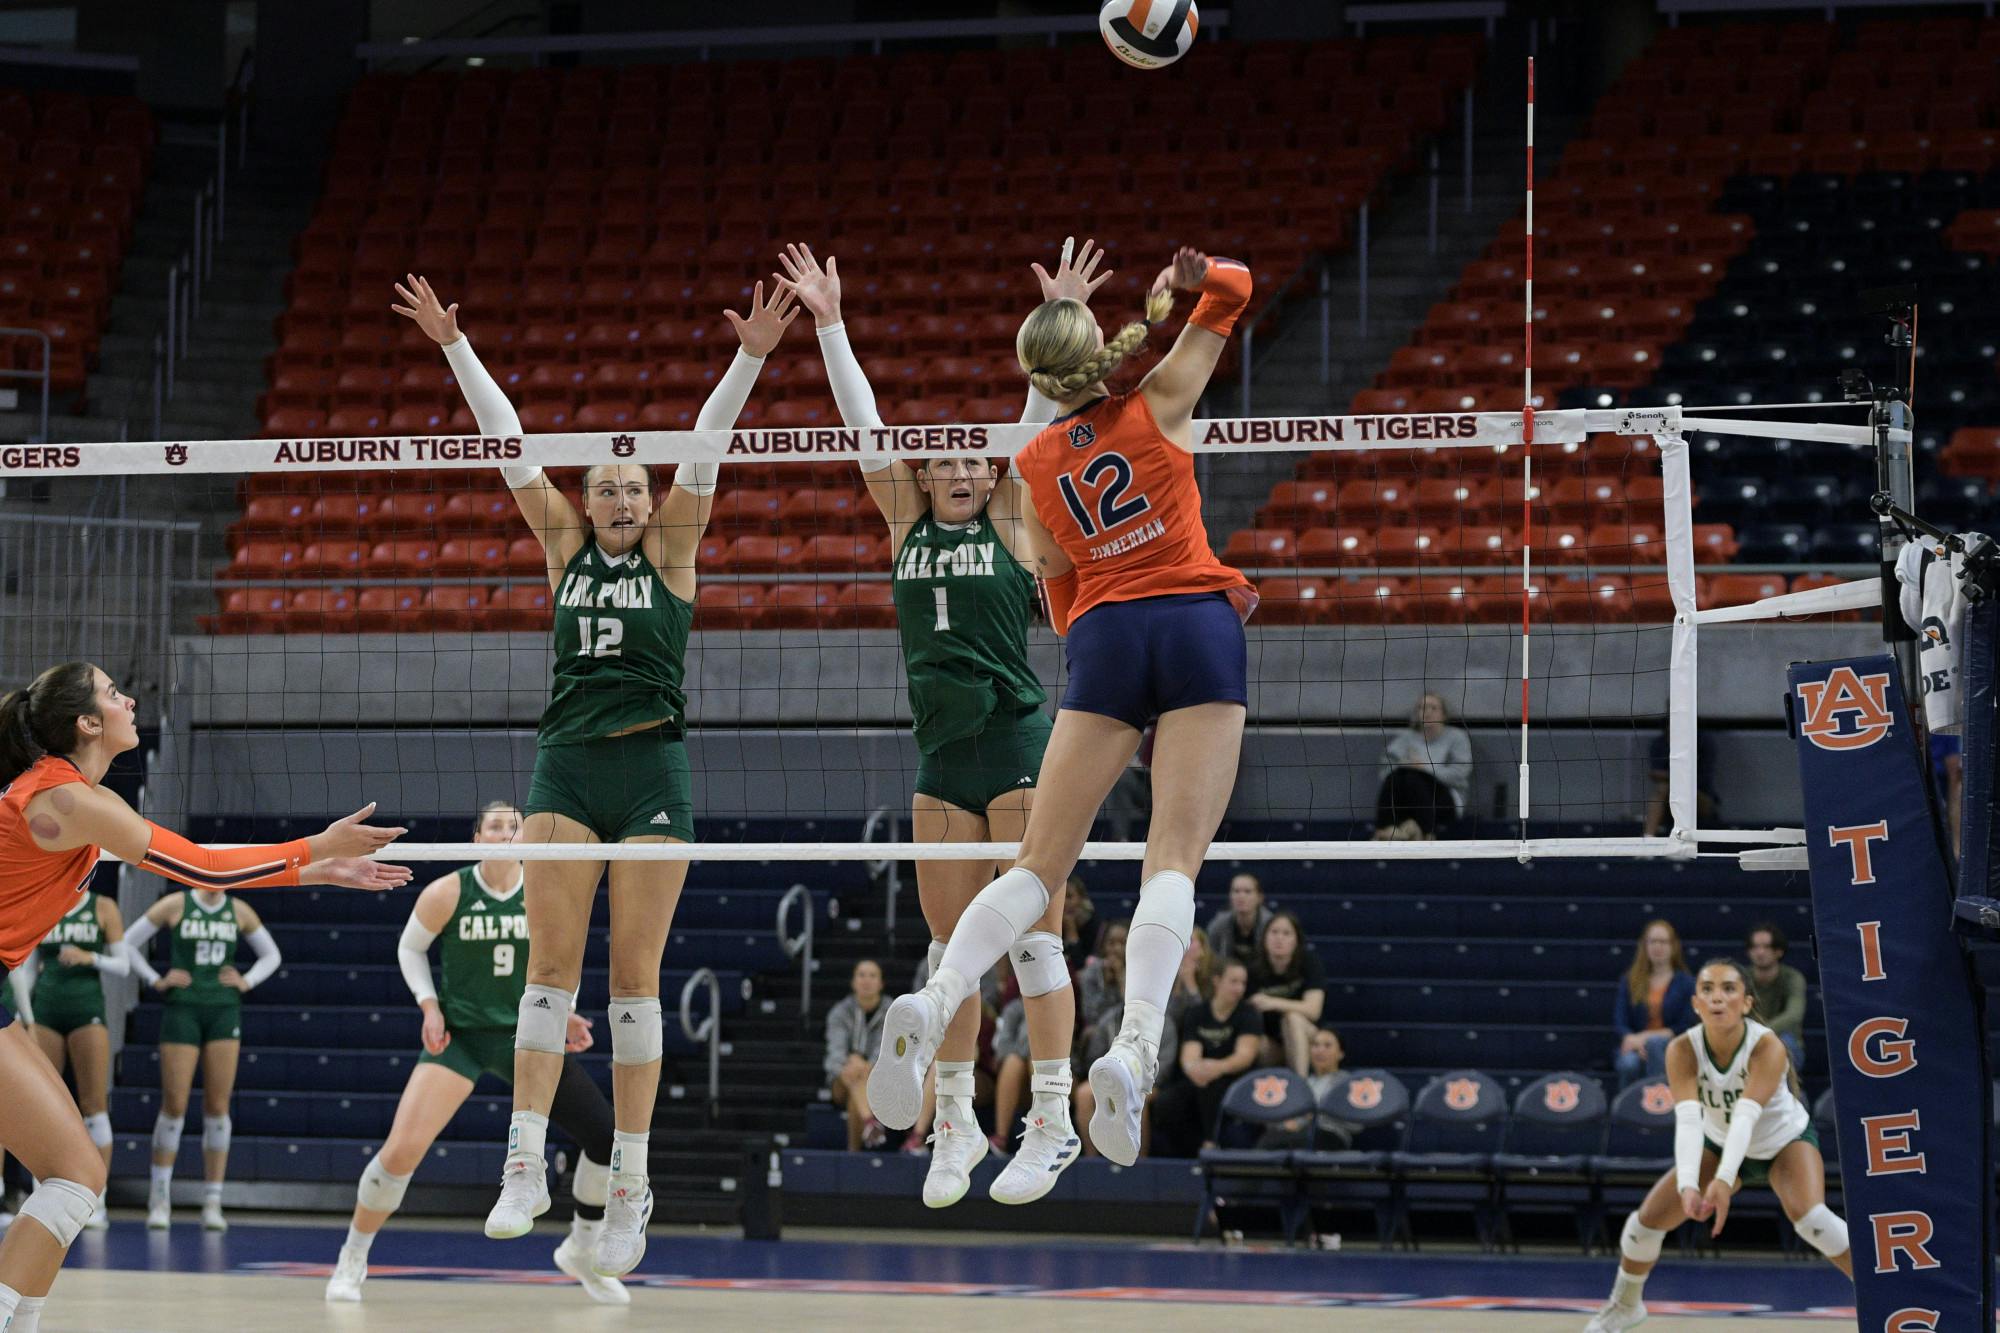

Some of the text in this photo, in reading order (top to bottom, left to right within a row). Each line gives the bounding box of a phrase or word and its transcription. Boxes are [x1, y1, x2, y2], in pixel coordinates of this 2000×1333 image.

[726, 427, 988, 455] AUBURN TIGERS
[1203, 415, 1477, 444] AUBURN TIGERS
[0, 446, 80, 469] GERS
[274, 436, 522, 463] AUBURN TIGERS
[1056, 451, 1151, 539] 12
[1089, 517, 1166, 560] ZIMMERMAN
[935, 542, 995, 578] POLY
[596, 574, 653, 608] POLY
[933, 587, 951, 631] 1
[577, 616, 624, 657] 12
[1796, 666, 1894, 751] AU
[64, 922, 98, 943] POLY
[180, 919, 238, 943] CAL POLY
[459, 914, 530, 941] CAL PO
[194, 940, 226, 965] 20
[493, 944, 515, 976] 9
